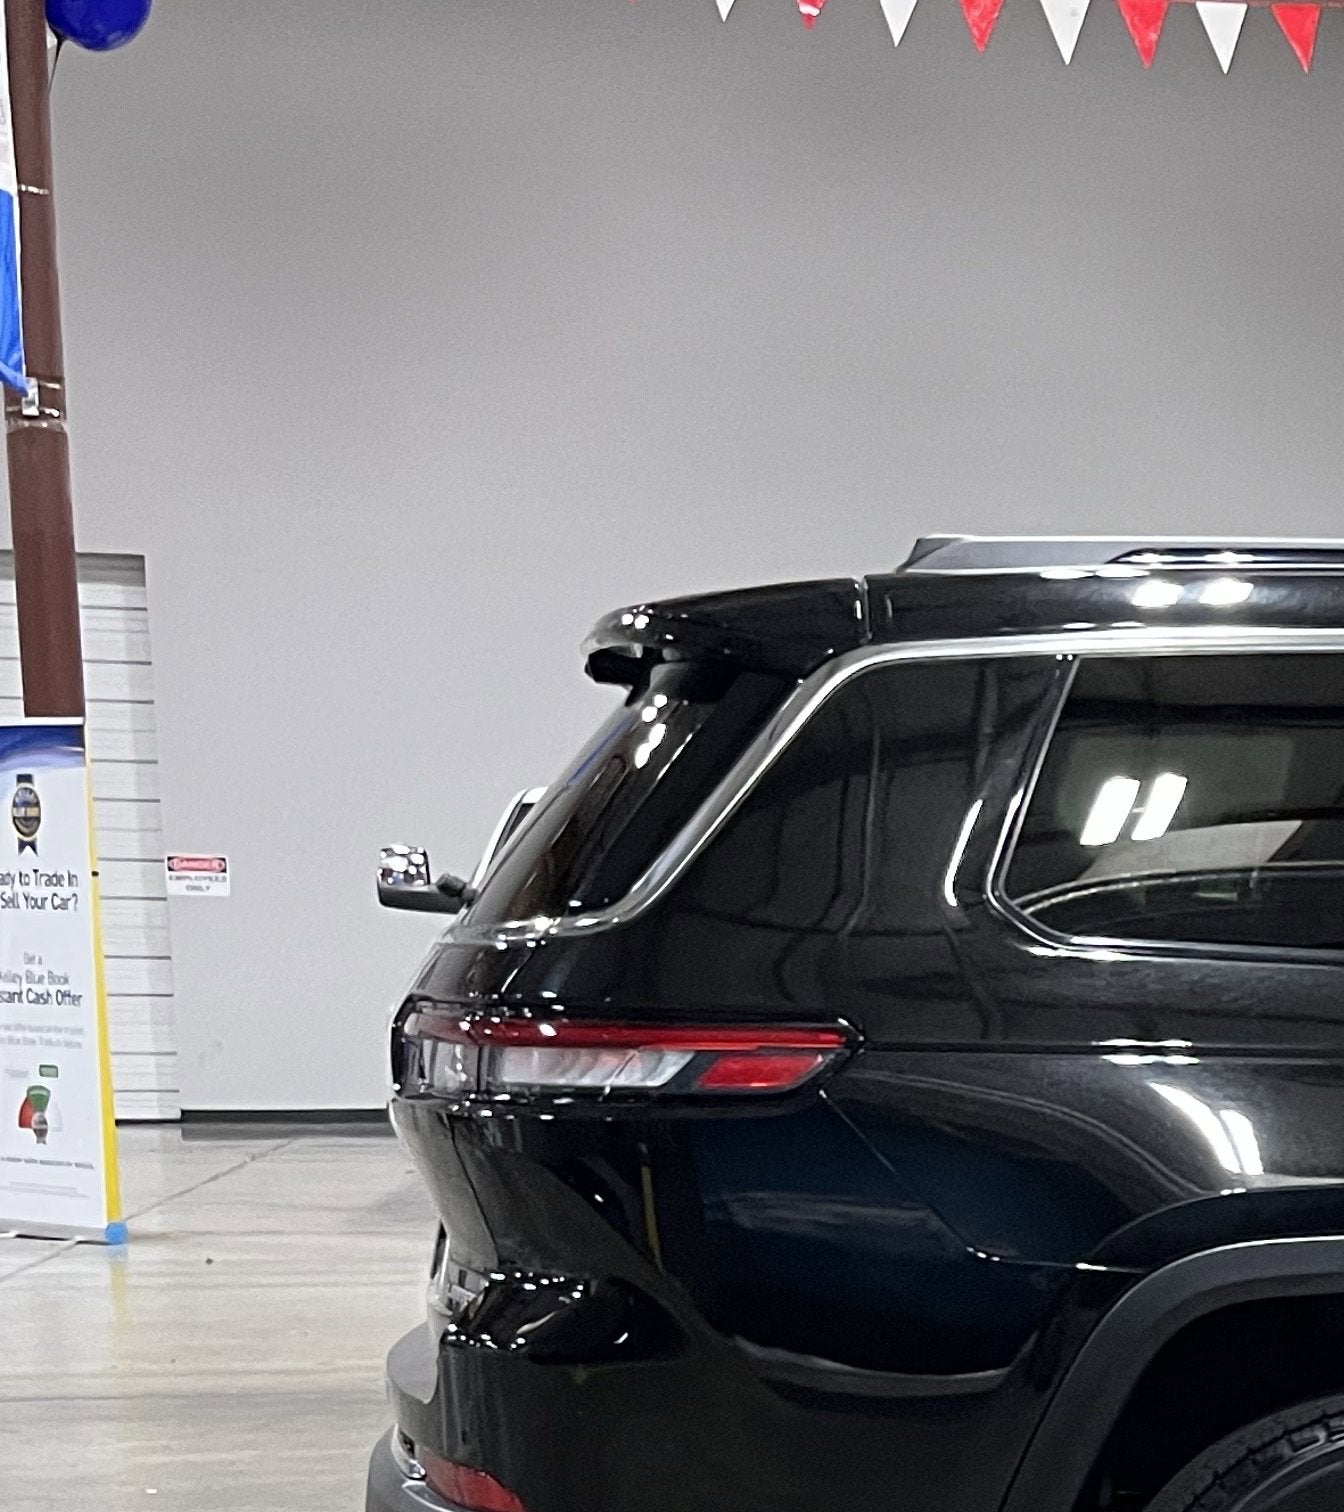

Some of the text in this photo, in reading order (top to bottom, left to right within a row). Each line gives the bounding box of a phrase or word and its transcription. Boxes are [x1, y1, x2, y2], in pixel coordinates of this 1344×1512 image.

[18, 871, 31, 887] to
[32, 869, 65, 887] Trade
[67, 870, 79, 887] In
[0, 892, 78, 911] Sell Your Car?
[26, 988, 53, 1005] Cash
[55, 989, 83, 1007] Offer
